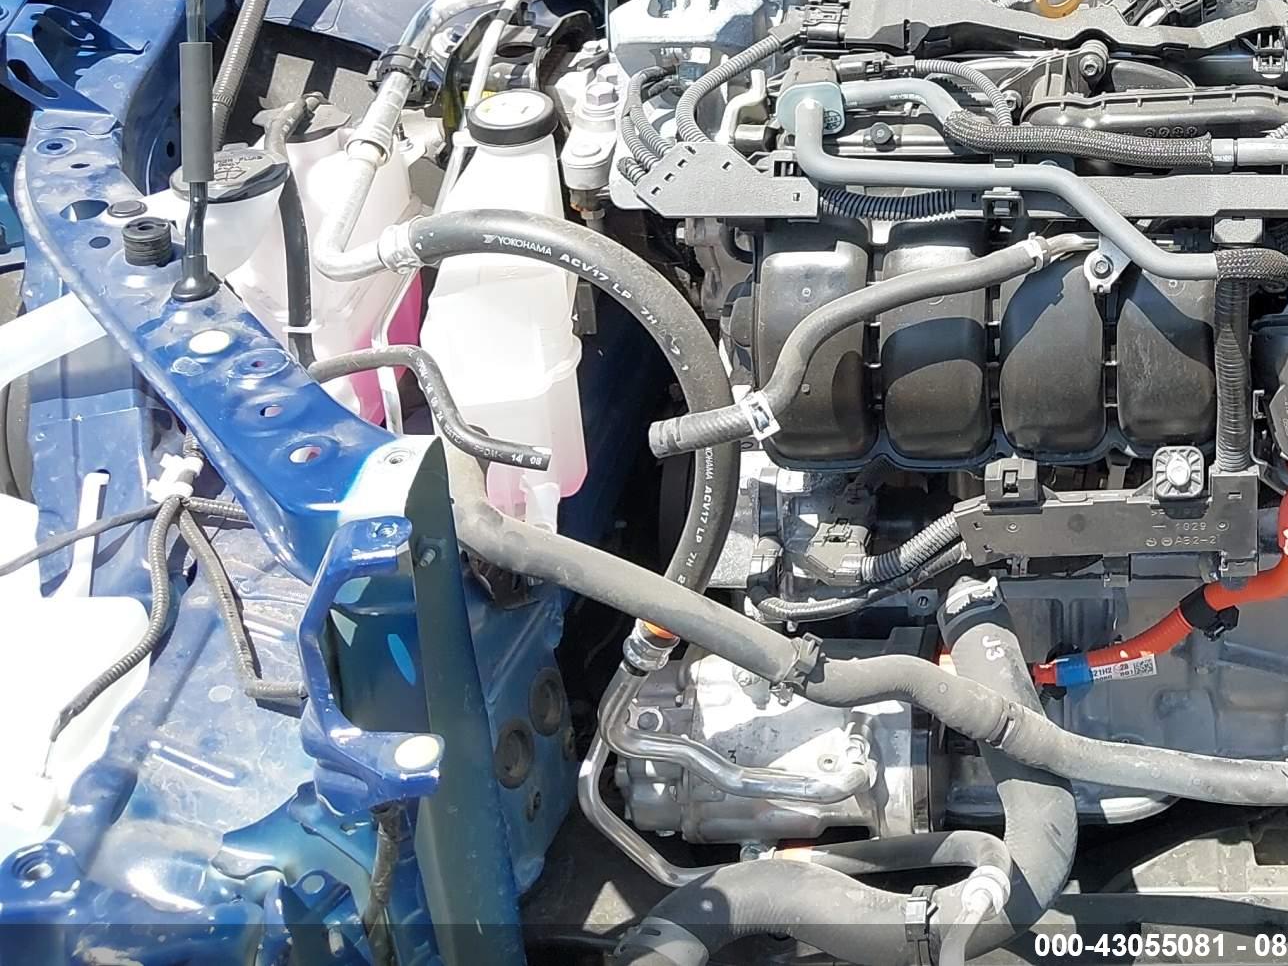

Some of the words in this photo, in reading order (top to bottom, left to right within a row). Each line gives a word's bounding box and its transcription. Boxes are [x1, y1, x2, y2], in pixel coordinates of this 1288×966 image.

[498, 235, 552, 256] YOKOHAMA
[559, 252, 609, 282] ACV17
[612, 282, 633, 300] LP
[700, 485, 712, 523] ACV17
[696, 528, 705, 543] LP
[982, 636, 1005, 661] J3
